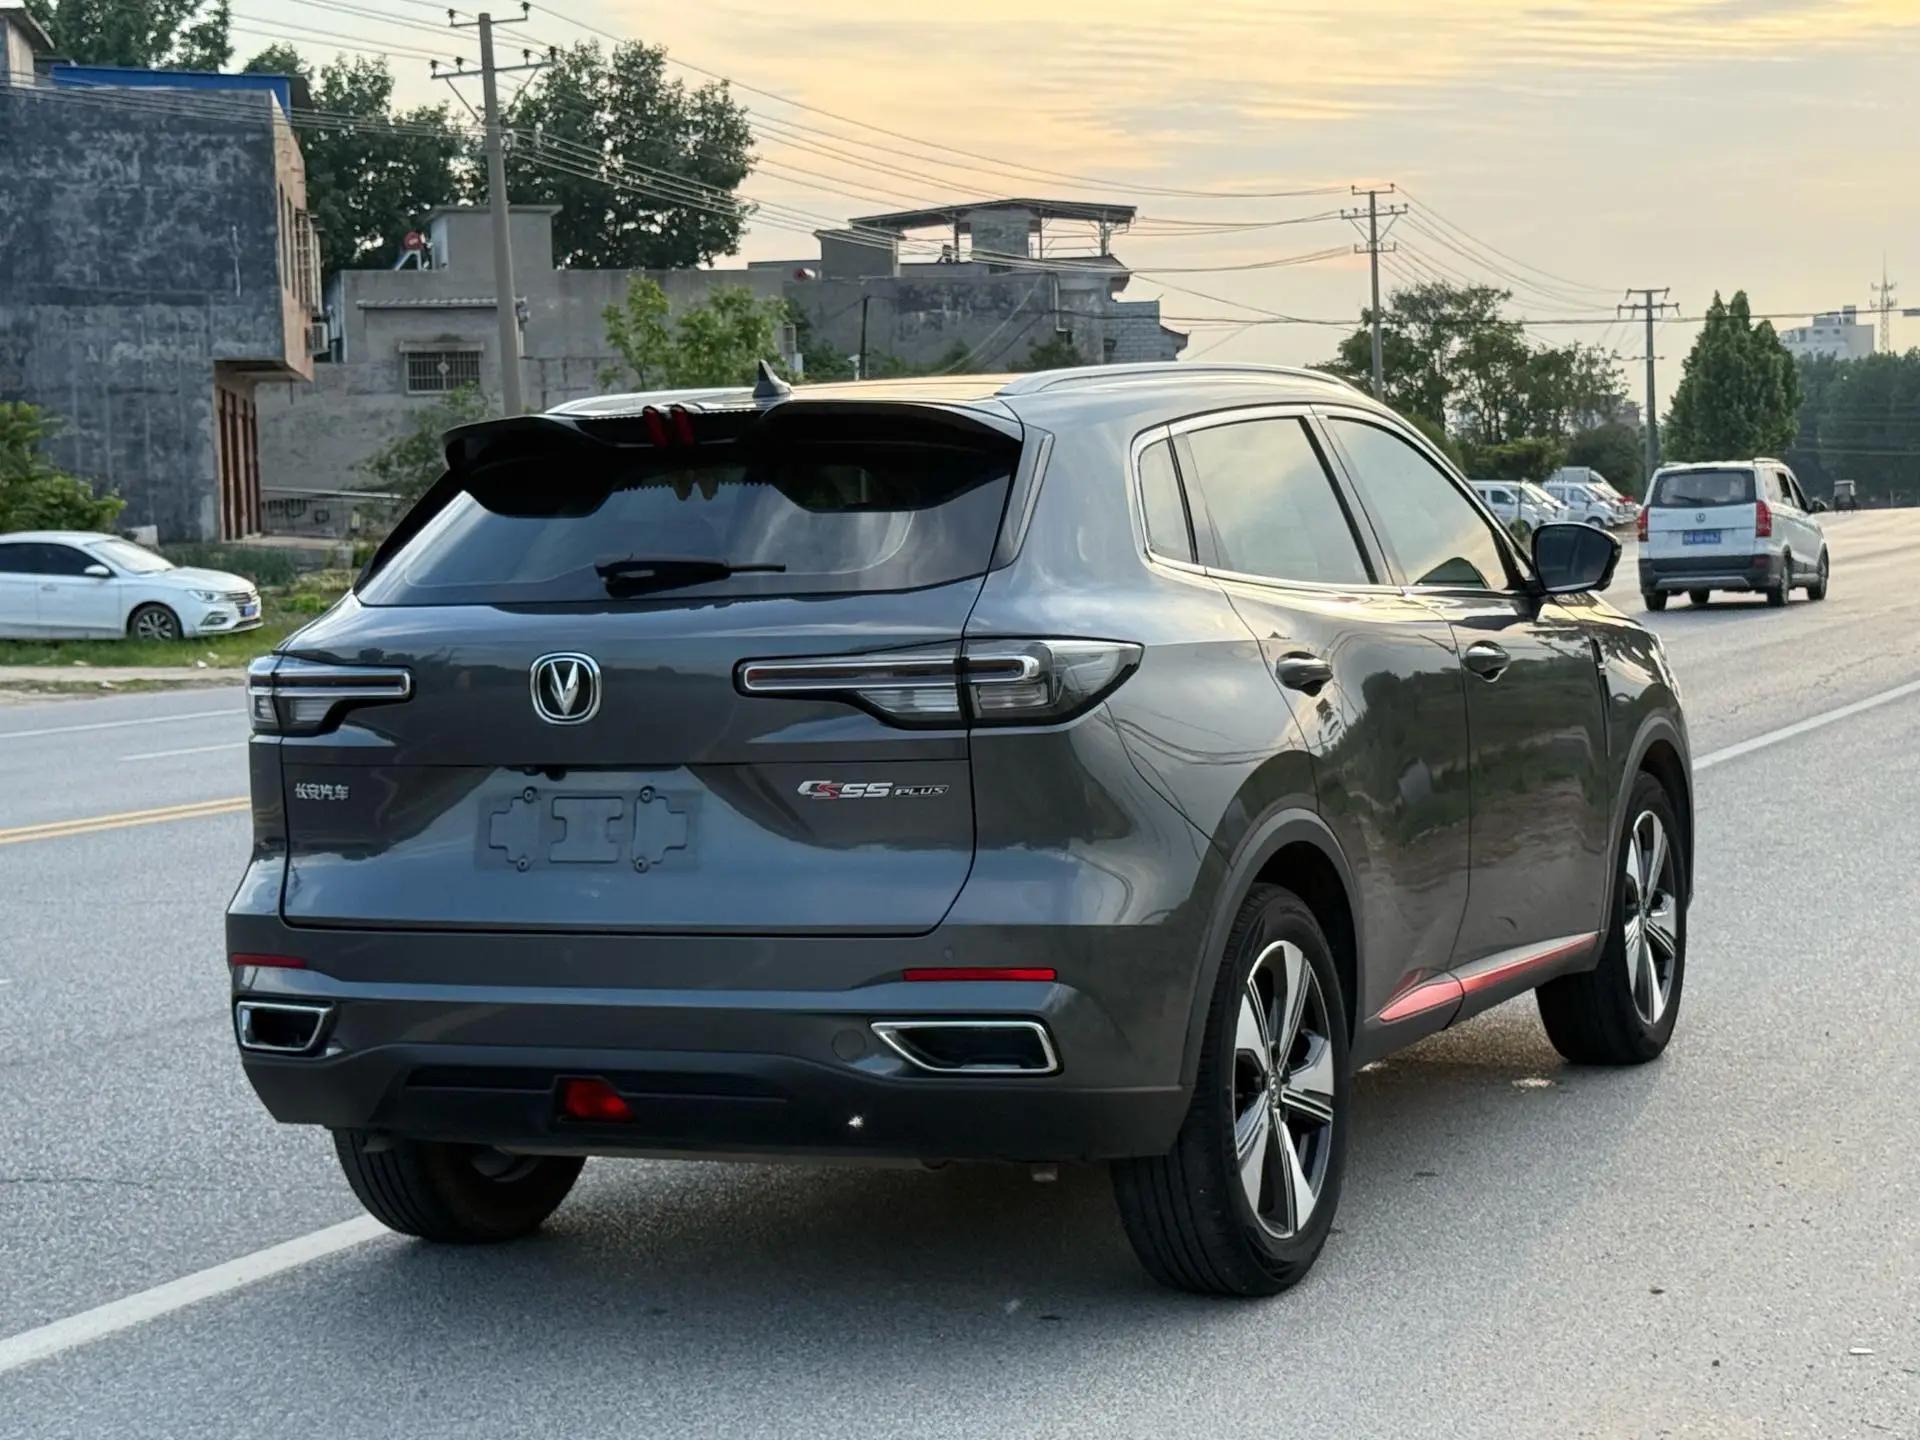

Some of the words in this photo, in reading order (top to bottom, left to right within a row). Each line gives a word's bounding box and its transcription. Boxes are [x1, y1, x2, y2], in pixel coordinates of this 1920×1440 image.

[294, 782, 349, 801] 长安汽车
[893, 786, 947, 797] PLUS
